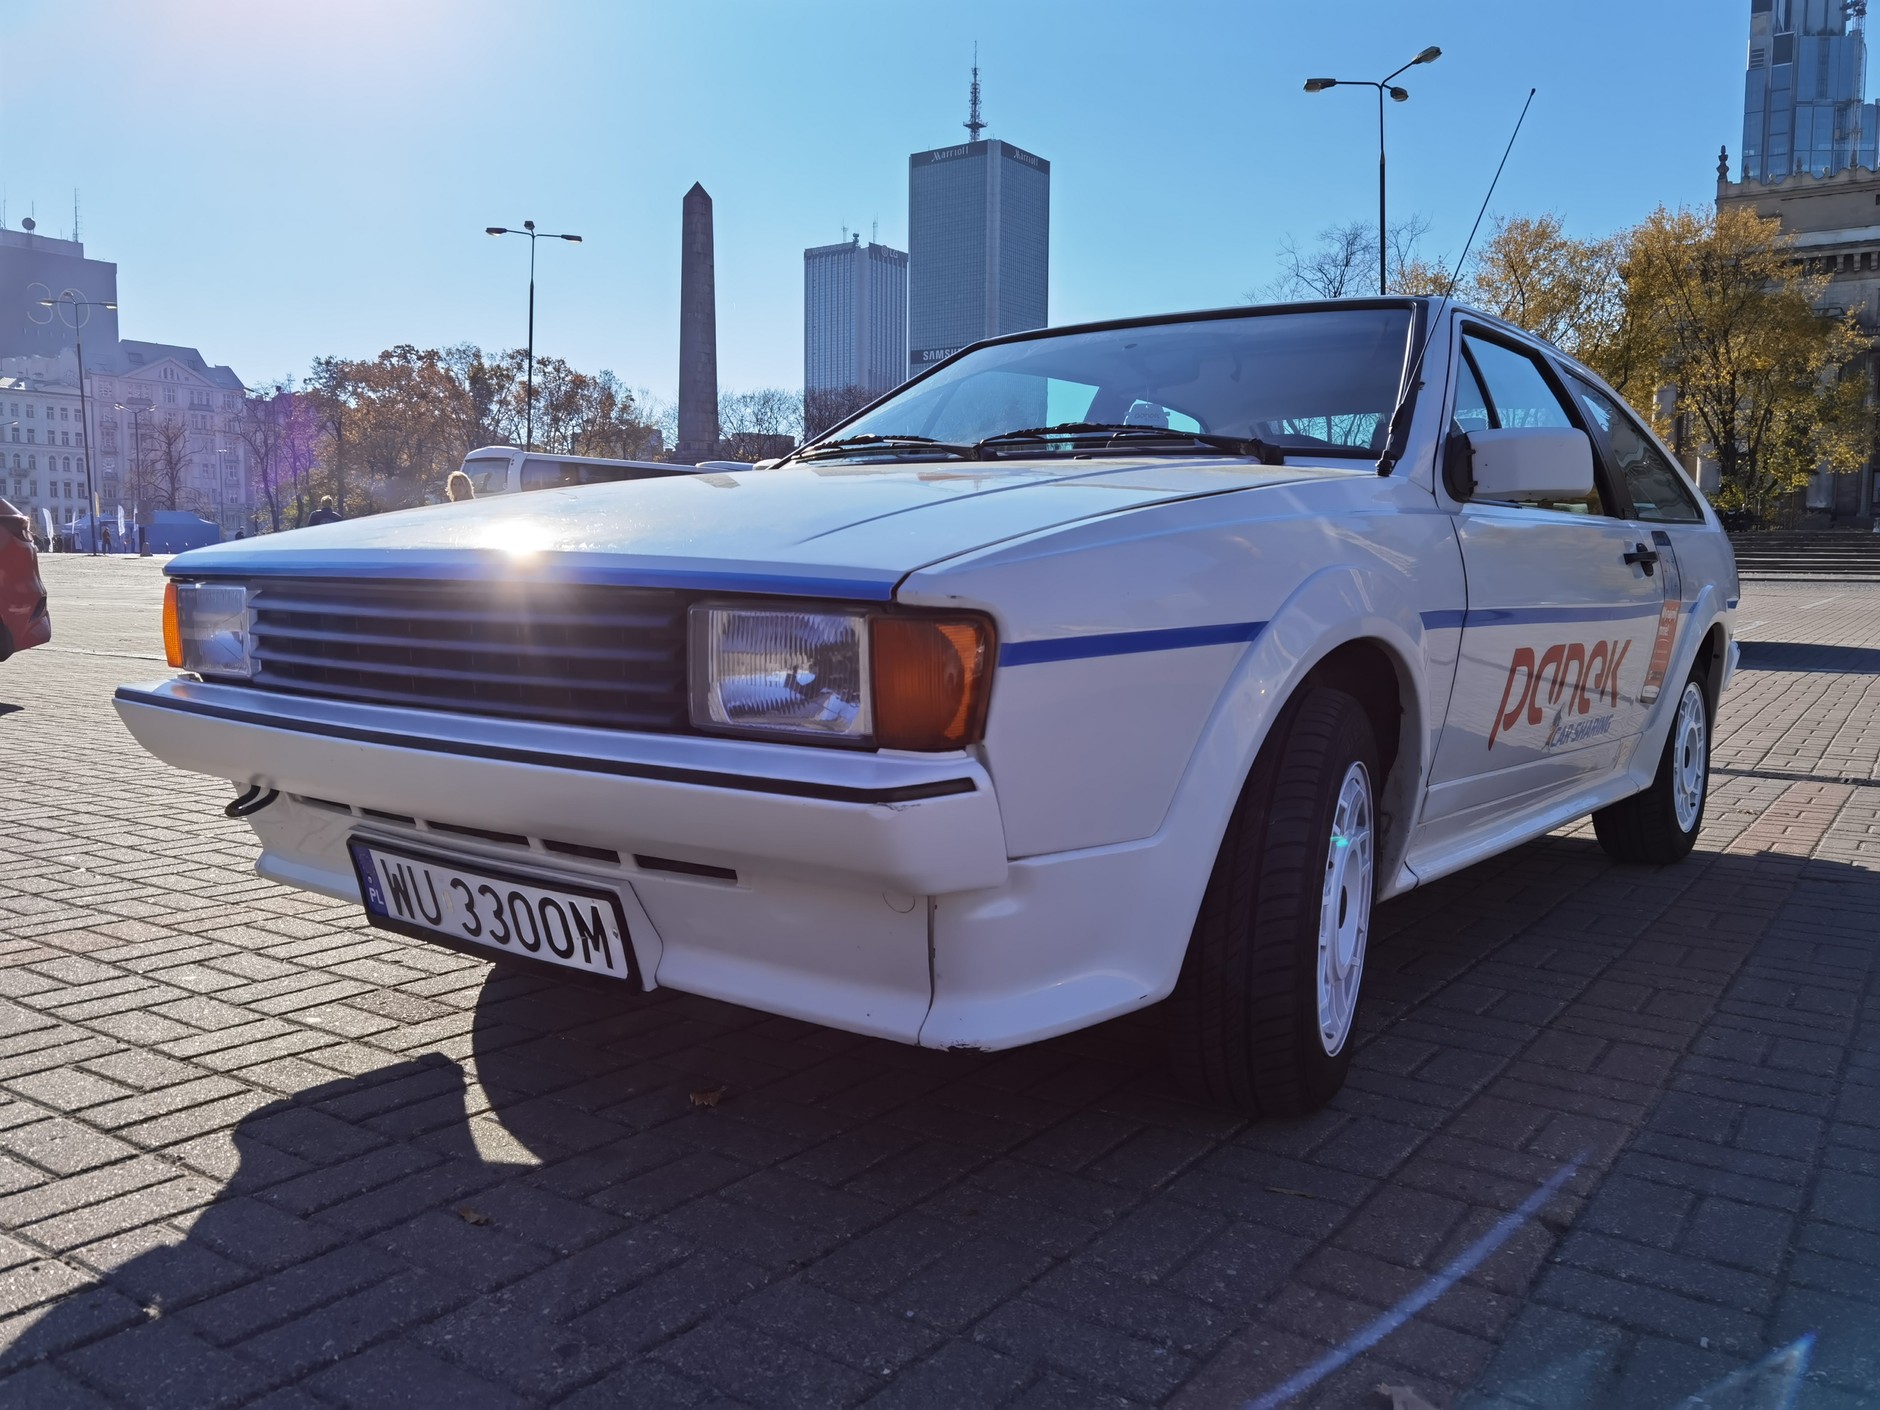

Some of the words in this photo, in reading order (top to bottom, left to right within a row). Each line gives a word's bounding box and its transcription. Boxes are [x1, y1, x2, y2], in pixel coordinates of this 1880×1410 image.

[931, 145, 969, 162] Marriott
[368, 887, 384, 905] PL
[380, 858, 442, 926] WU
[450, 877, 615, 970] 3300M
